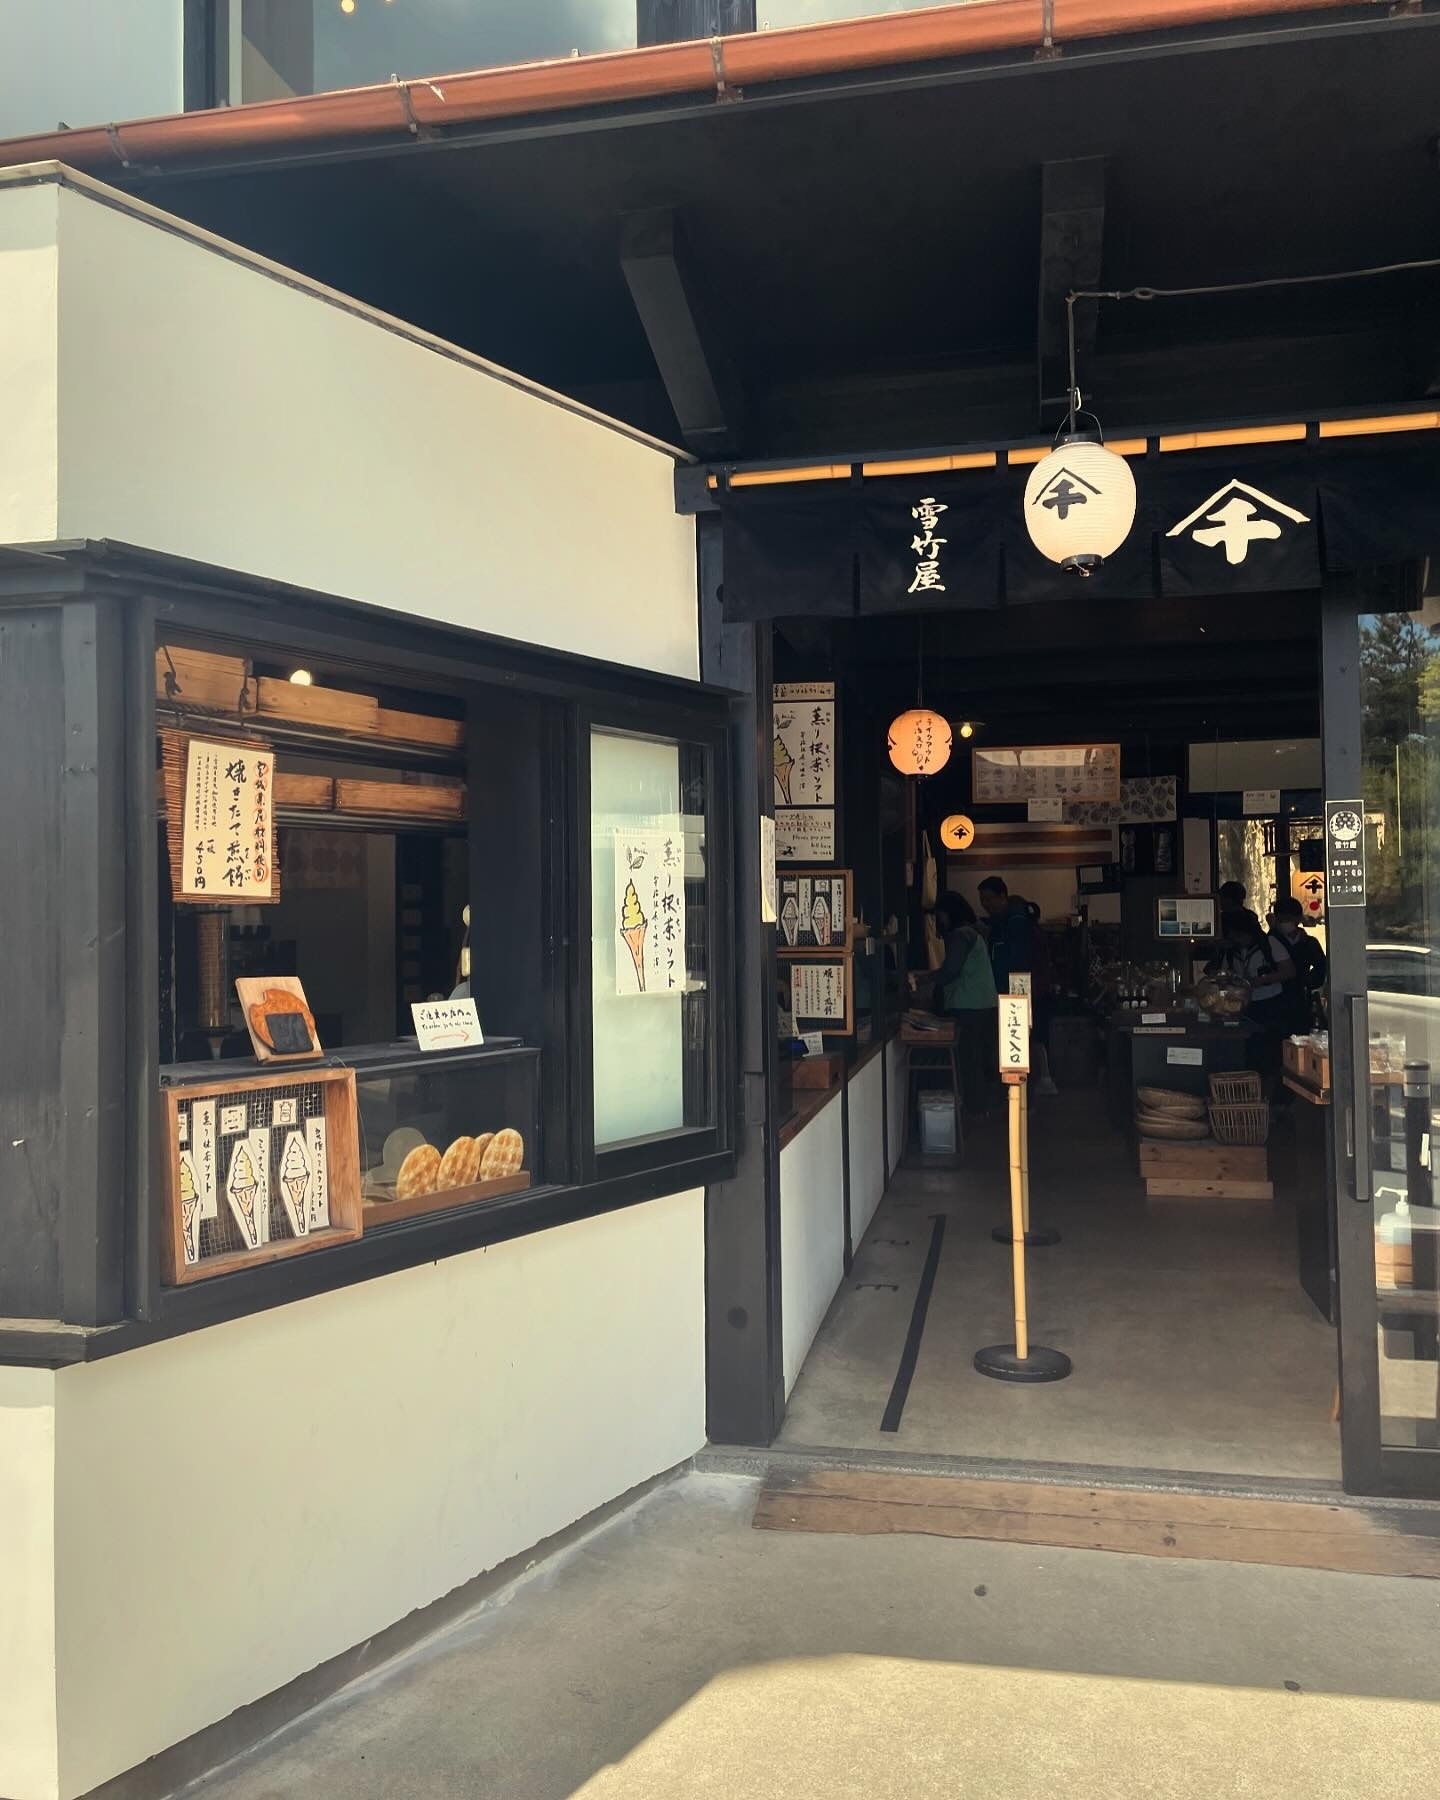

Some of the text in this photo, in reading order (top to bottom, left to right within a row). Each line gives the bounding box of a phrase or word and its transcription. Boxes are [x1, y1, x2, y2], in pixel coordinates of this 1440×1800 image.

[907, 496, 949, 594] 雪竹屋
[222, 759, 247, 887] 焼きたて煎餅
